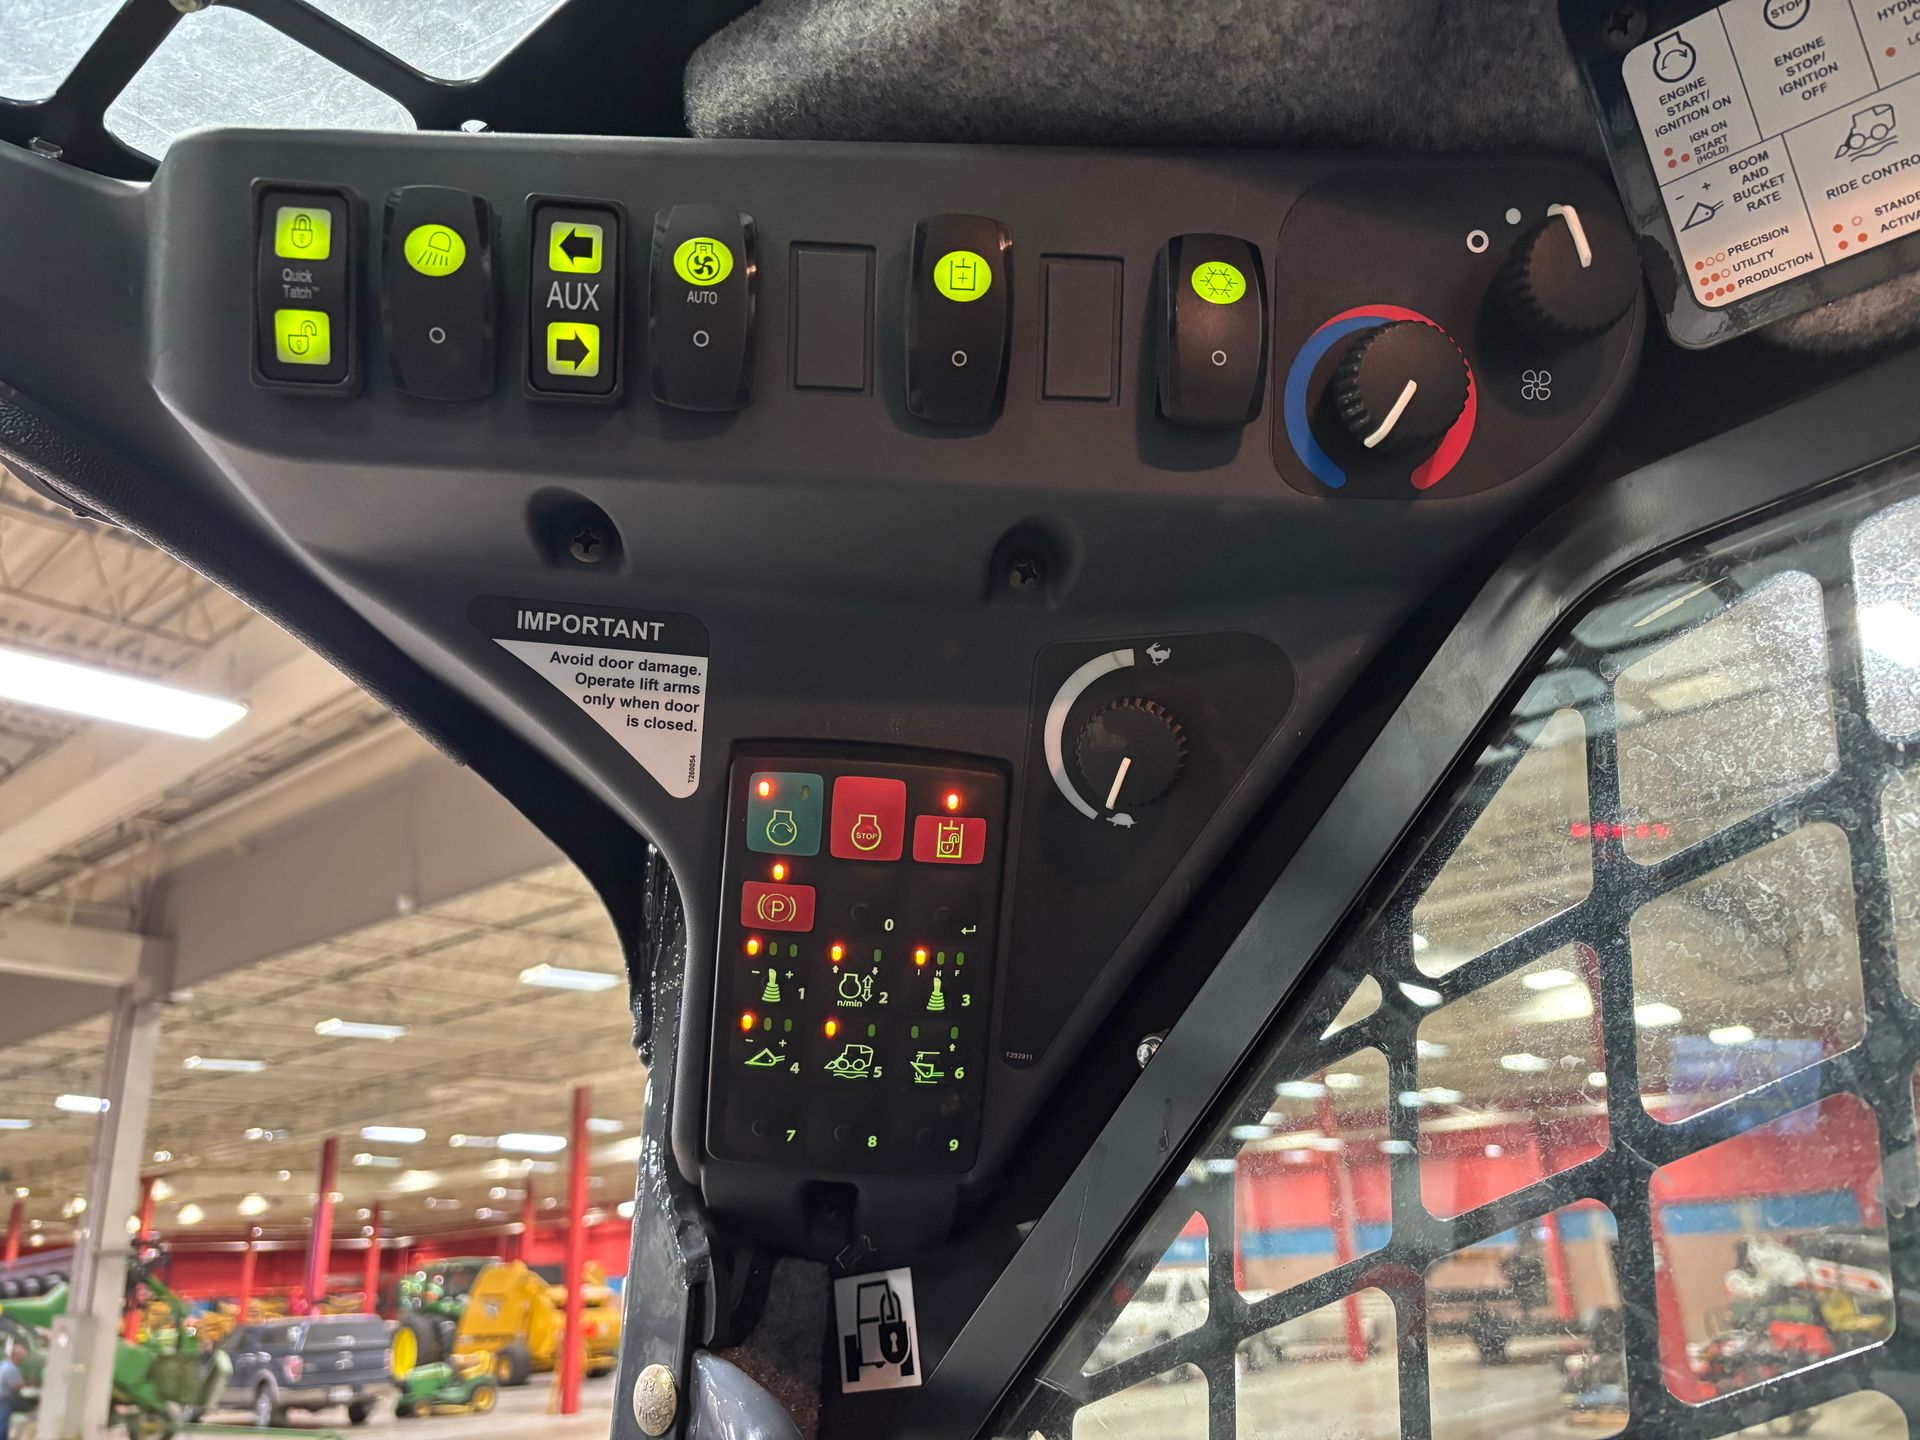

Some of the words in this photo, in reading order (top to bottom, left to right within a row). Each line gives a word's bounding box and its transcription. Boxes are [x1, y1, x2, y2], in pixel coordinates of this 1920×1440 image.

[1774, 36, 1826, 67] ENGINE
[1785, 51, 1826, 77] STOP/
[1779, 61, 1839, 96] IGNITION
[1659, 76, 1707, 106] ENGINE
[1801, 82, 1828, 101] OFF
[1666, 89, 1710, 117] START/
[1655, 105, 1709, 138] IGNITION
[1712, 95, 1732, 111] ON
[1689, 128, 1709, 144] IGN
[1711, 120, 1728, 133] ON
[1694, 134, 1728, 156] START
[1696, 145, 1729, 166] (HOLD)
[1729, 150, 1769, 175] BOOM
[1742, 166, 1769, 185] AND
[1732, 173, 1786, 203] BUCKET
[1826, 179, 1859, 200] RIDE
[1746, 190, 1782, 213] RATE
[1727, 225, 1789, 257] PRECISION
[1732, 249, 1775, 272] UTILITY
[1737, 252, 1814, 288] PRODUCTION
[282, 268, 312, 283] Quick
[546, 281, 600, 311] AUX
[686, 290, 718, 305] AUTO
[517, 609, 665, 641] IMPORTANT
[550, 651, 593, 666] Avoid
[598, 655, 634, 670] door
[638, 658, 702, 677] damage.
[575, 672, 635, 689] Operate
[639, 676, 659, 691] lift
[663, 681, 700, 694] arms
[582, 693, 615, 709] only
[620, 696, 660, 710] when
[664, 699, 700, 713] door
[626, 714, 639, 728] is
[643, 716, 698, 732] closed.
[855, 831, 878, 840] STOP
[771, 900, 785, 918] P
[884, 918, 895, 931] 0
[798, 987, 805, 1000] 1
[837, 1000, 863, 1008] n/min
[878, 991, 889, 1004] 2
[961, 994, 971, 1007] 3
[789, 1062, 800, 1074] 4
[873, 1066, 883, 1078] 5
[954, 1067, 965, 1079] 6
[786, 1129, 797, 1142] 7
[867, 1135, 878, 1147] 8
[949, 1139, 959, 1151] 9
